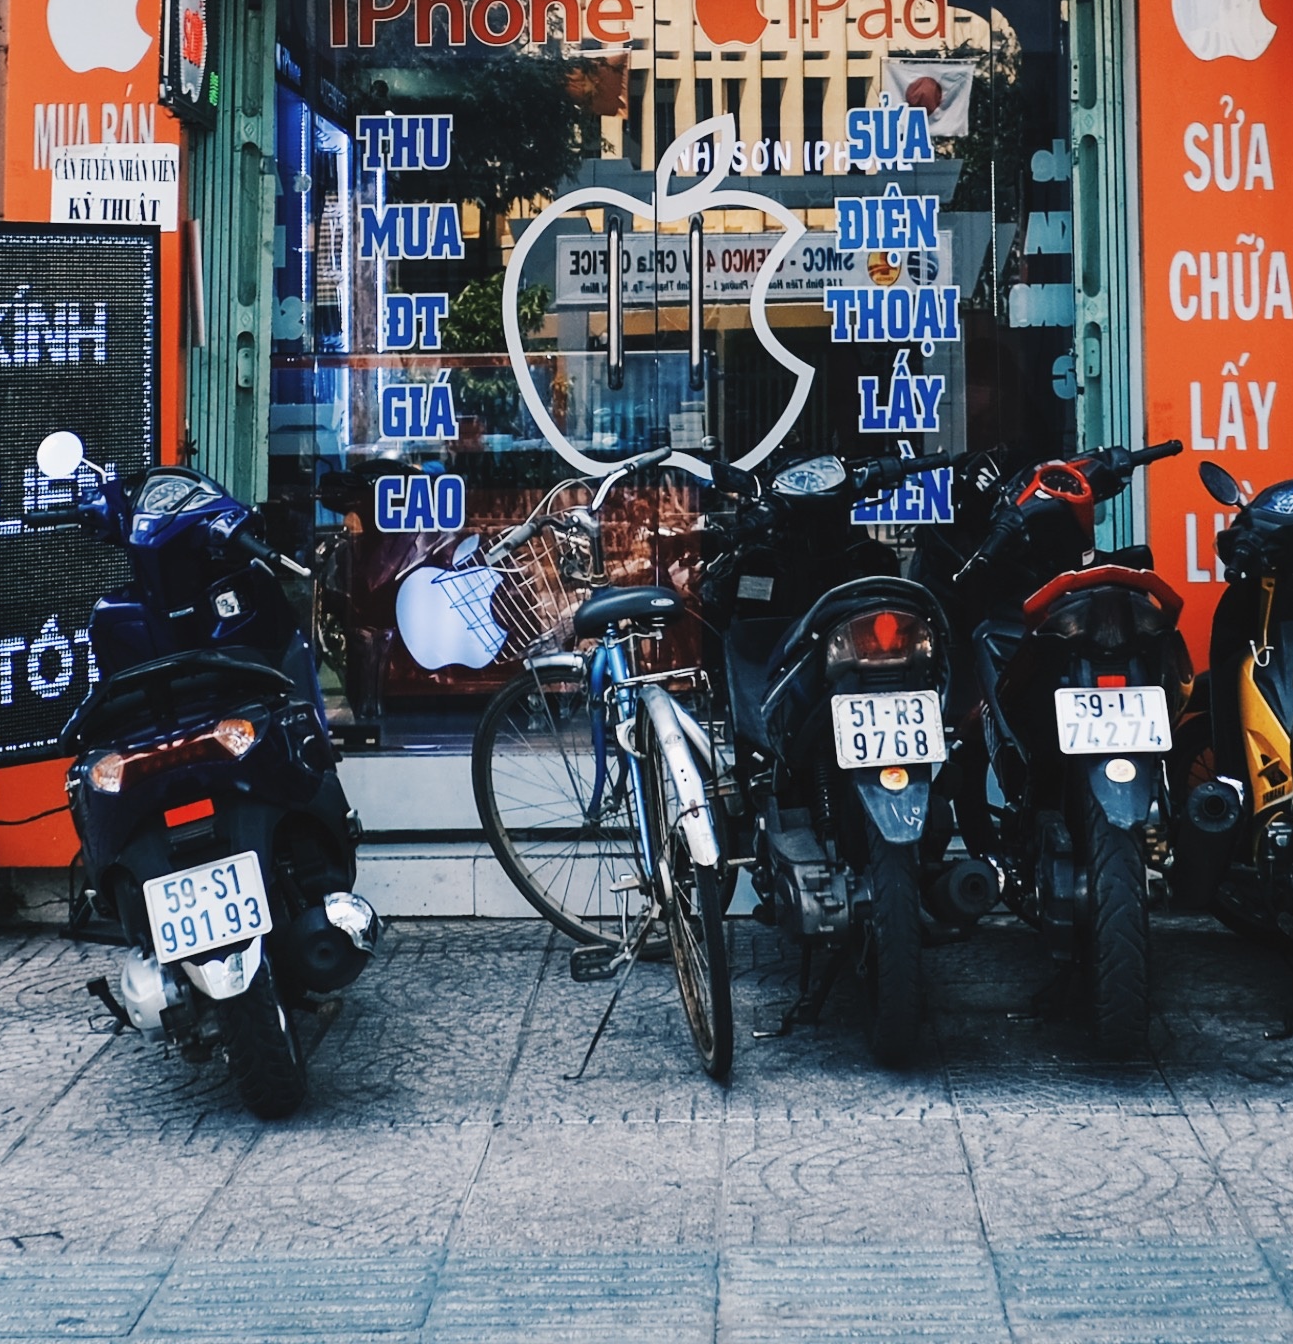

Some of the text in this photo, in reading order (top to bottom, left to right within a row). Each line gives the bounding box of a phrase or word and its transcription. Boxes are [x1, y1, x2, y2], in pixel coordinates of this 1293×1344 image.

[355, 113, 454, 172] THU
[846, 92, 935, 163] SỬA
[1182, 93, 1275, 191] SỬA
[358, 202, 465, 260] MUA
[835, 182, 939, 268] ĐIỆN
[1168, 232, 1293, 321] CHỮA
[383, 293, 449, 350] ĐT
[824, 285, 961, 357] THOẠI
[379, 367, 459, 440] GIÁ
[858, 348, 946, 433] LẤY
[1190, 352, 1277, 451] LẤY
[374, 474, 466, 533] CAO
[849, 697, 925, 729] 51-R3
[1073, 692, 1146, 719] 59-L1
[853, 730, 930, 761] 9768
[162, 863, 243, 914] 59-S1
[160, 896, 263, 954] 991.93
